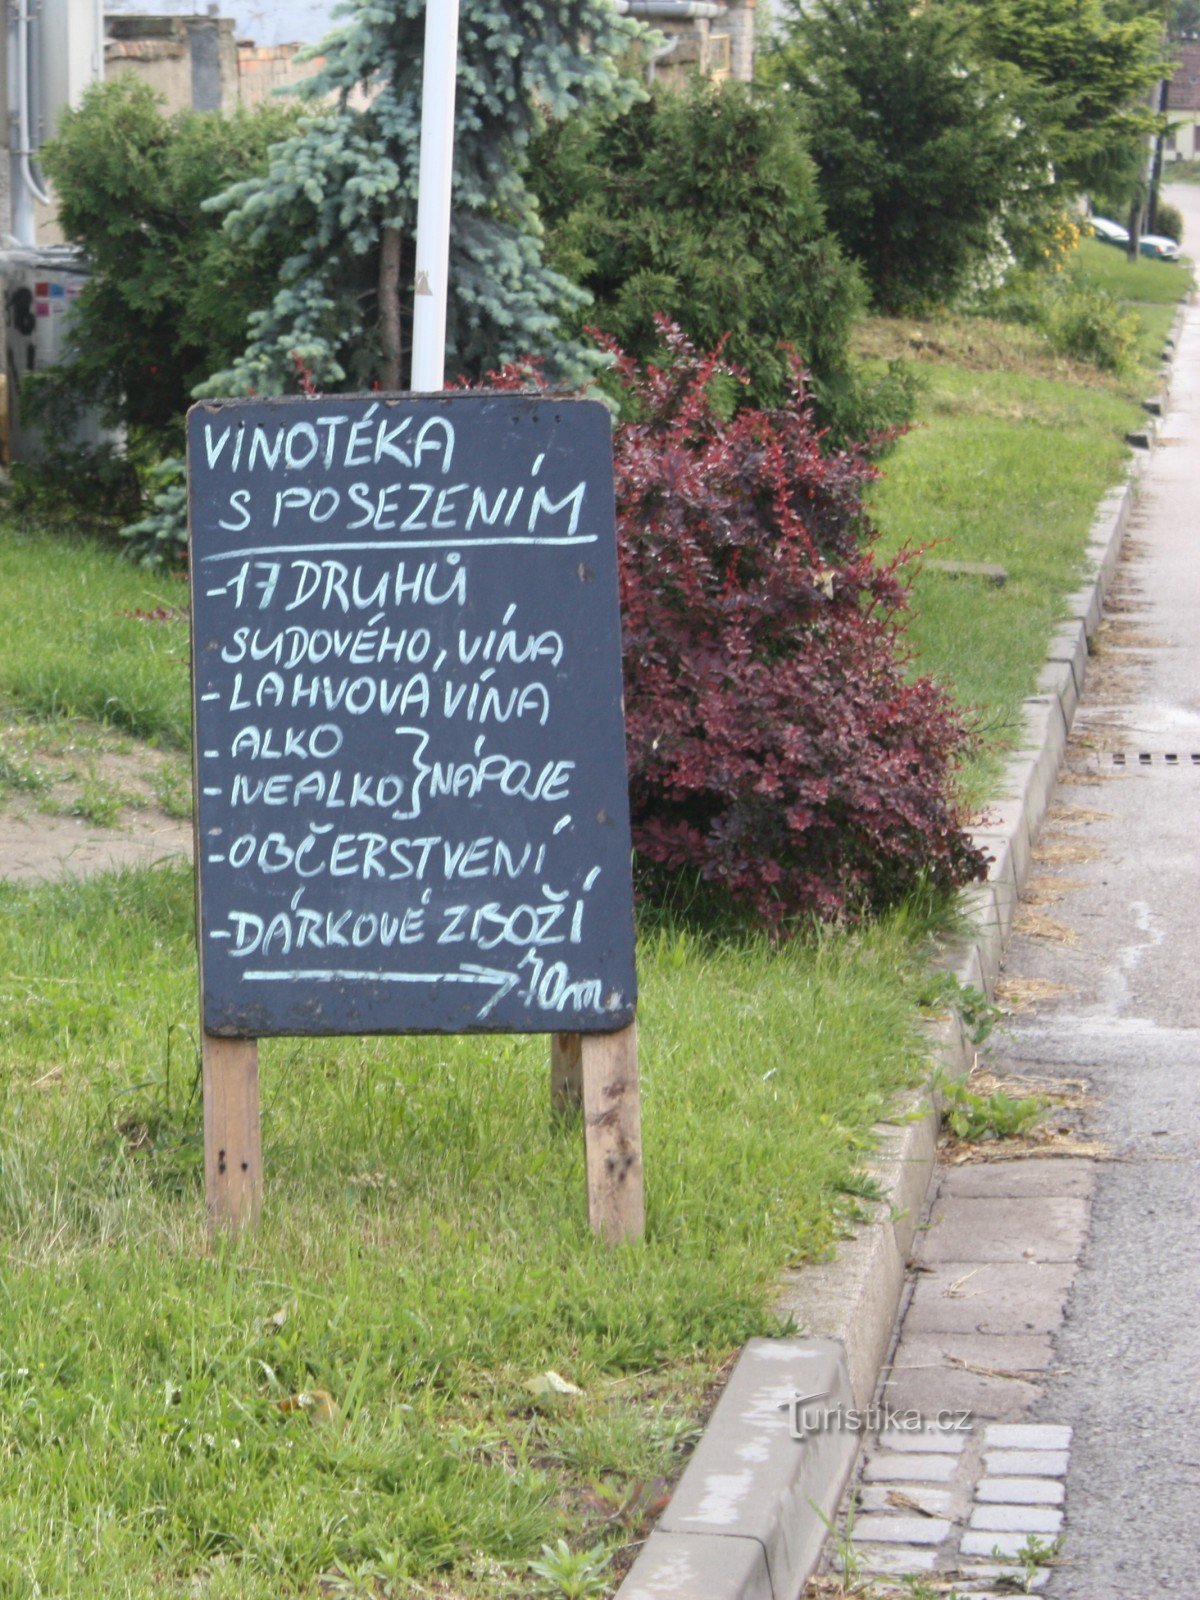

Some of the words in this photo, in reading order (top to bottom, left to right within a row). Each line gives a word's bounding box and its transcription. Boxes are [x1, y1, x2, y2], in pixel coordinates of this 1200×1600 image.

[204, 403, 456, 474] VINOTÉKA
[219, 489, 251, 531] S
[272, 453, 587, 536] POSEZENÍM
[285, 552, 467, 613] DRUHŮ
[220, 612, 448, 673] SUDOVÉHO,
[458, 603, 563, 667] VÍNA
[443, 668, 550, 726] VÍNA
[430, 735, 576, 801] NÁPOJE
[437, 866, 601, 949] ZBOŽÍ
